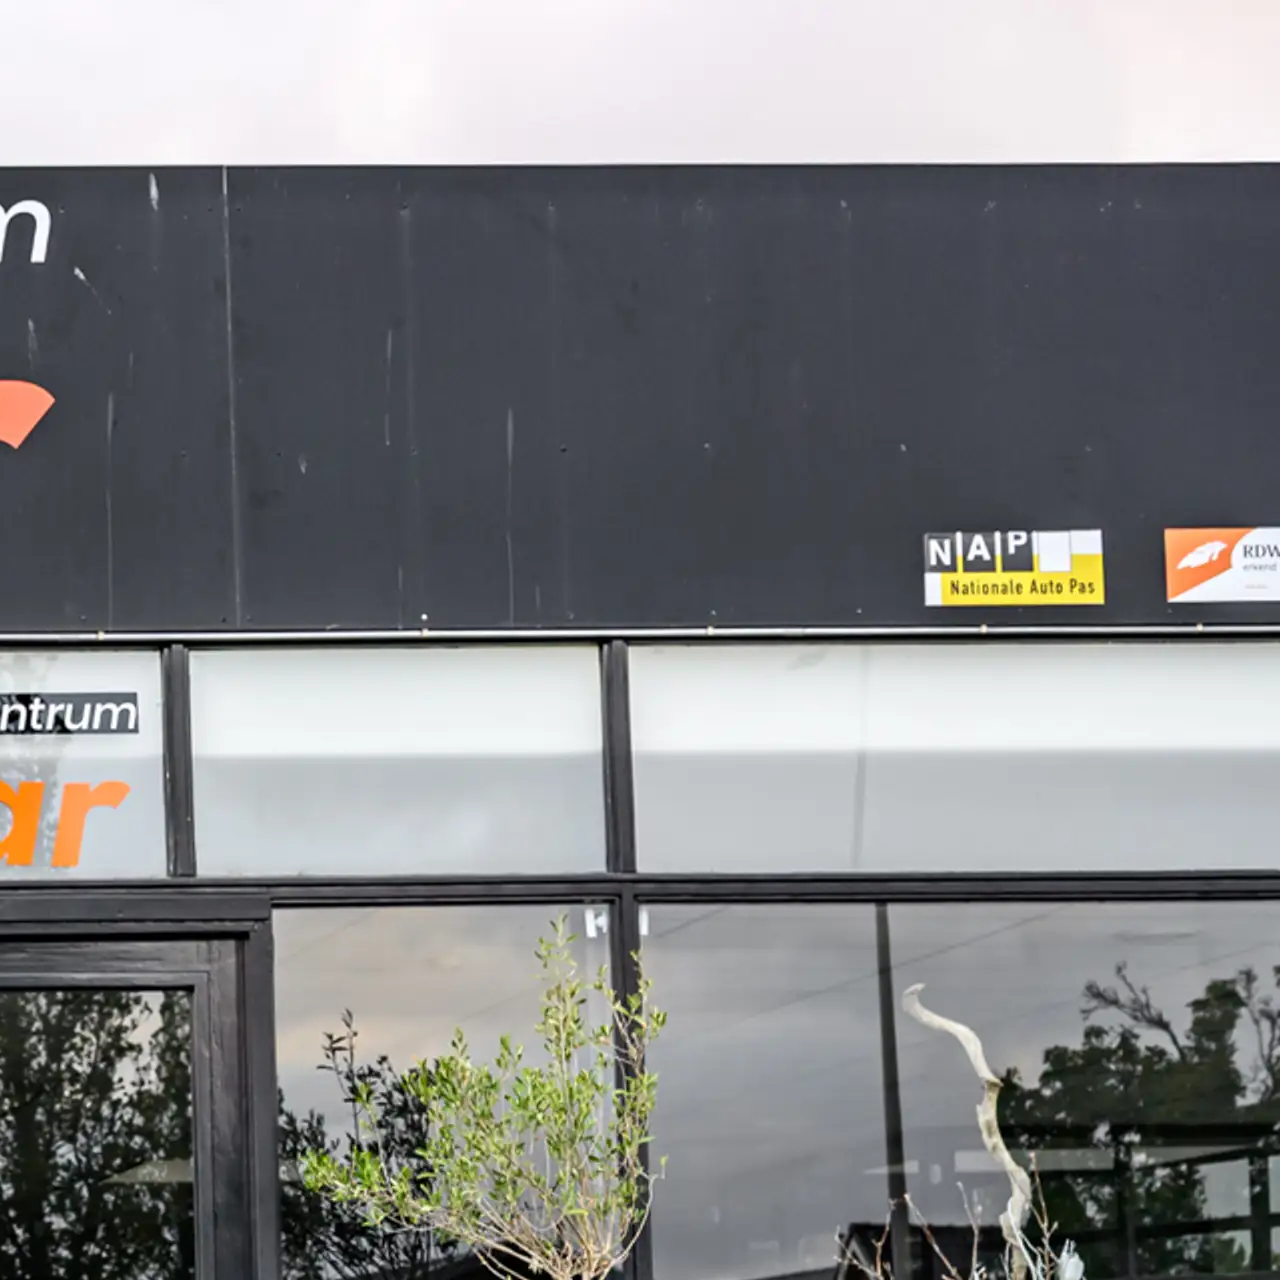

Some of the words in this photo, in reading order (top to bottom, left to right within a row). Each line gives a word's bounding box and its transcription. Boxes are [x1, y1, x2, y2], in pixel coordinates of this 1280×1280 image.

[950, 579, 1024, 596] Nationale
[1029, 578, 1064, 595] Auto
[1069, 577, 1095, 595] Pas
